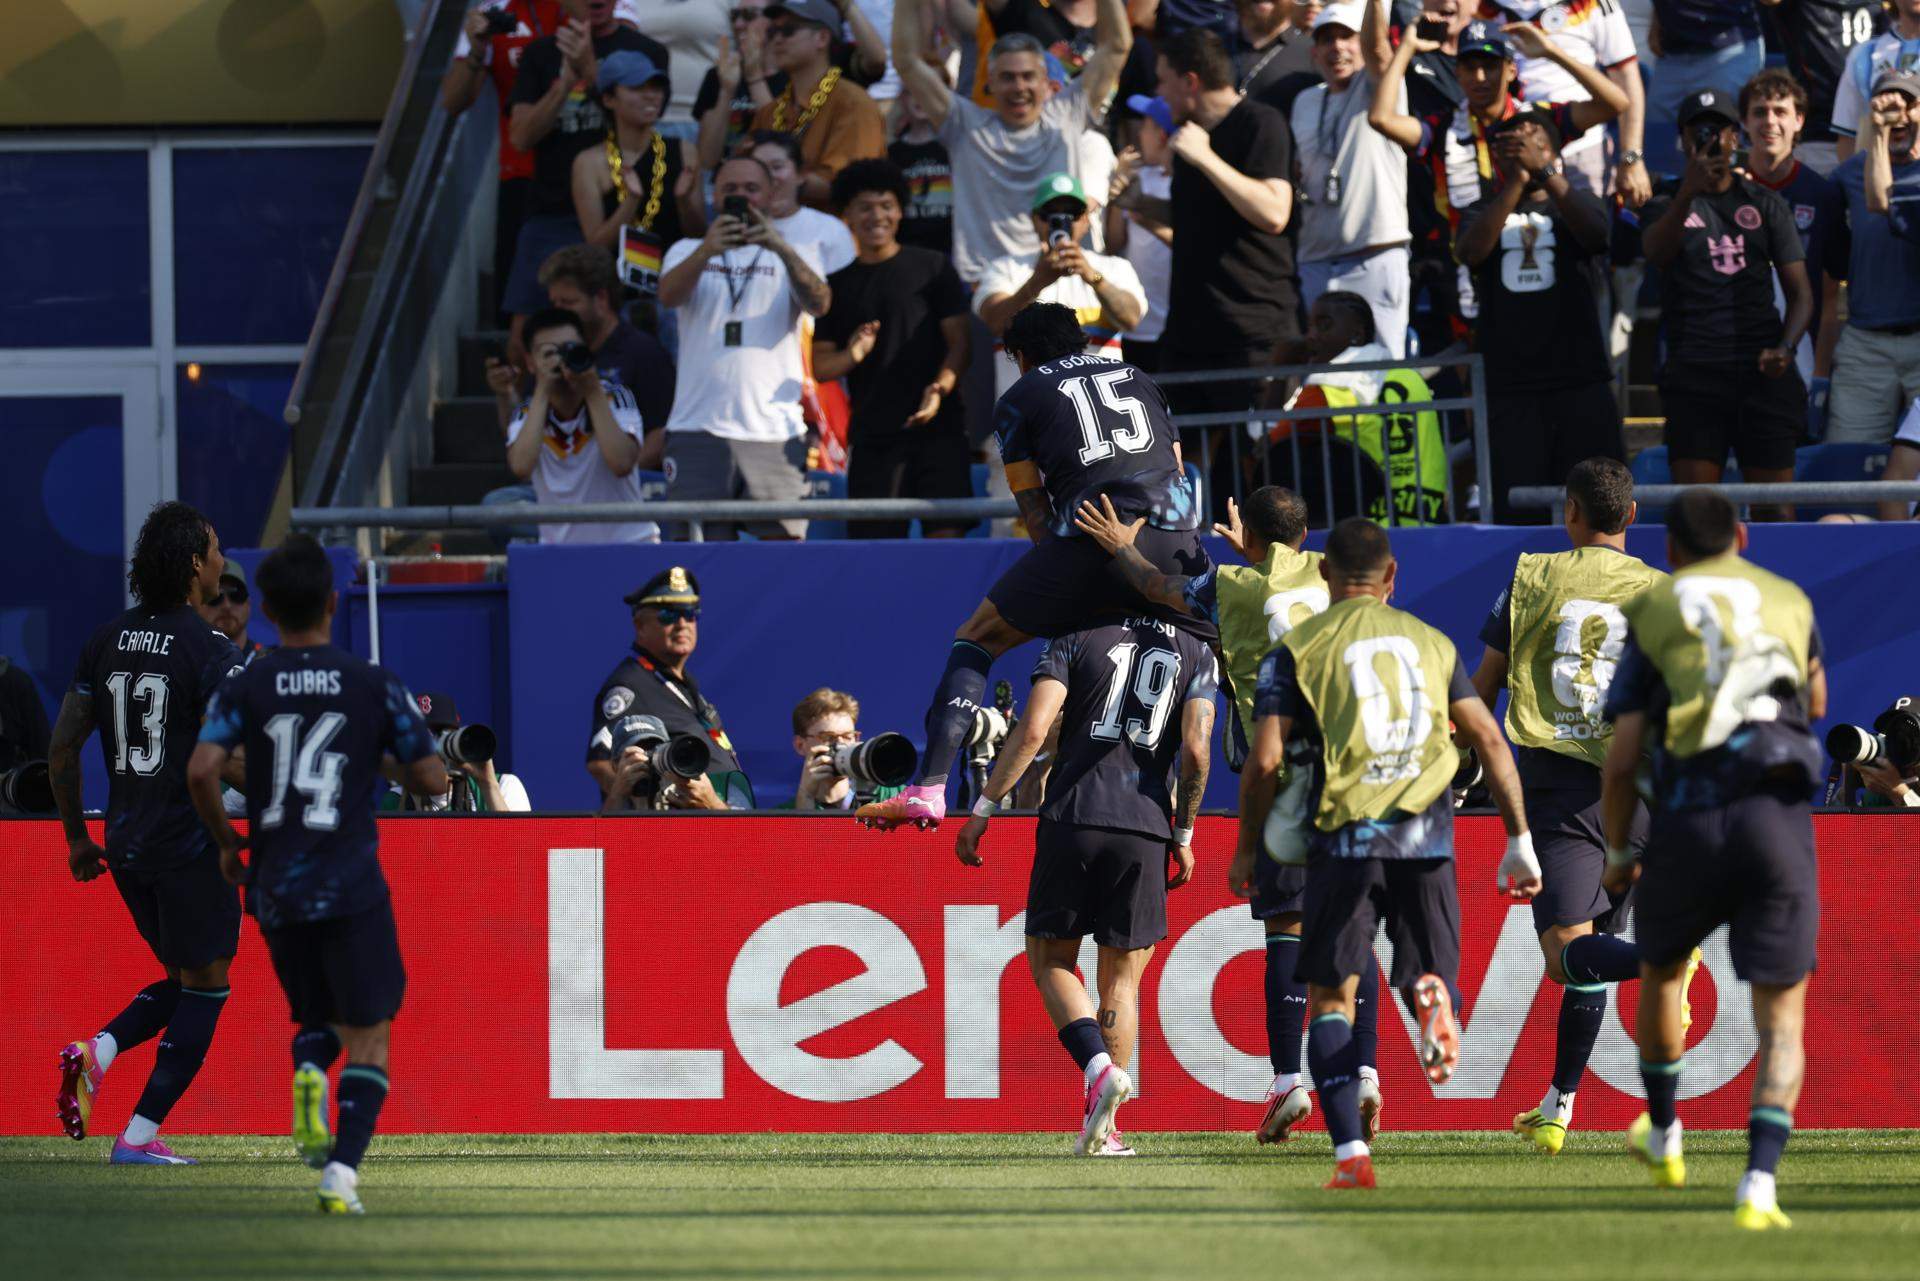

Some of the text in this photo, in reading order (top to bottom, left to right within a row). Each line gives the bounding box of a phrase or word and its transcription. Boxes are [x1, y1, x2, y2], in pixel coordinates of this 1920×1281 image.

[1842, 7, 1872, 47] 10
[1517, 274, 1542, 284] FIFA
[1058, 367, 1154, 466] 15
[117, 629, 175, 656] CANALE
[275, 669, 342, 696] CUBAS
[1090, 642, 1182, 752] 19
[105, 671, 170, 777] 13
[260, 711, 350, 832] 14
